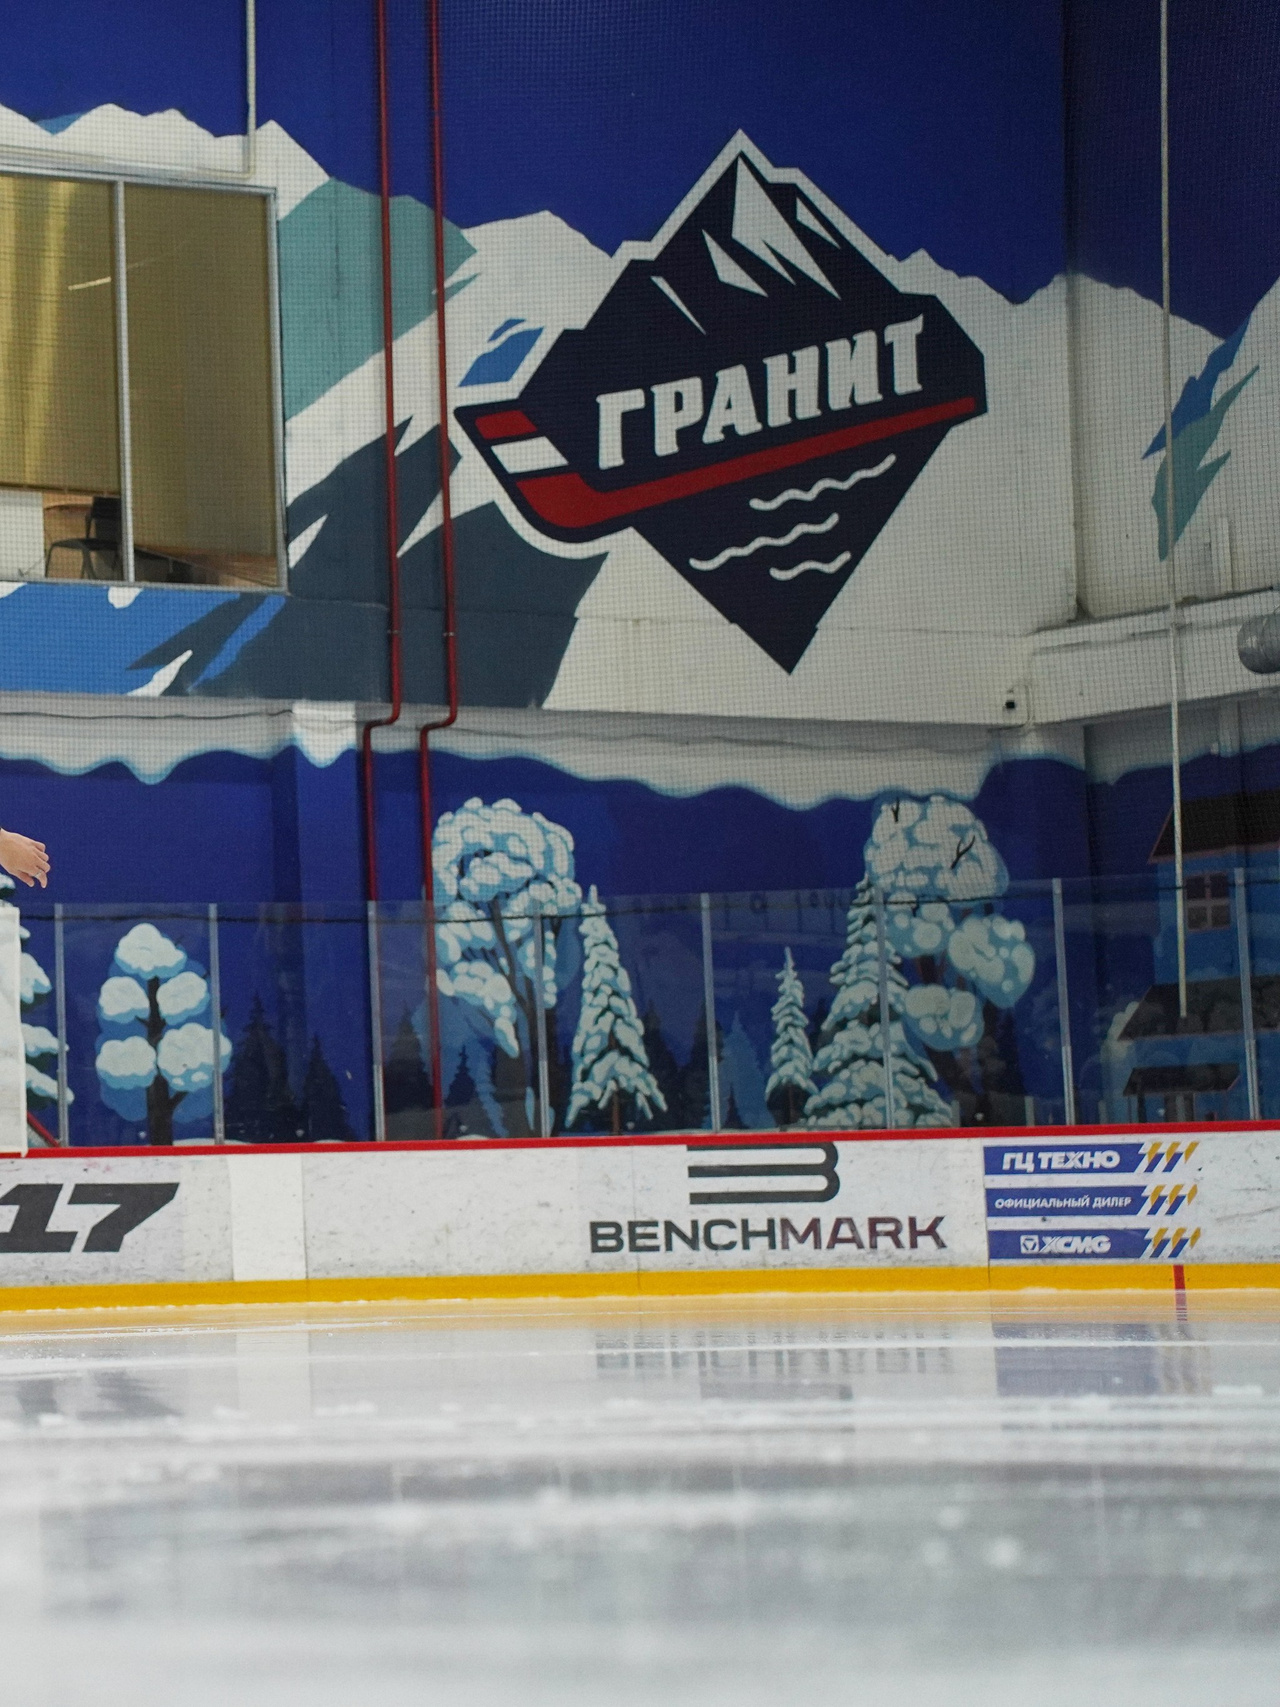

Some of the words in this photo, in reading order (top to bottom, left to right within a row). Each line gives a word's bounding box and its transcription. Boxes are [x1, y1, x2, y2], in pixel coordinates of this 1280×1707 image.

[596, 313, 925, 471] ГРАНИТ
[1002, 1151, 1035, 1173] ГЦ
[1037, 1150, 1120, 1169] ТЕХНО
[994, 1194, 1090, 1210] ОФИЦИАЛЬНЫЙ
[1092, 1196, 1132, 1209] ДИЛЕР
[589, 1215, 948, 1254] BENCHMARK
[1039, 1234, 1112, 1255] XCMG
